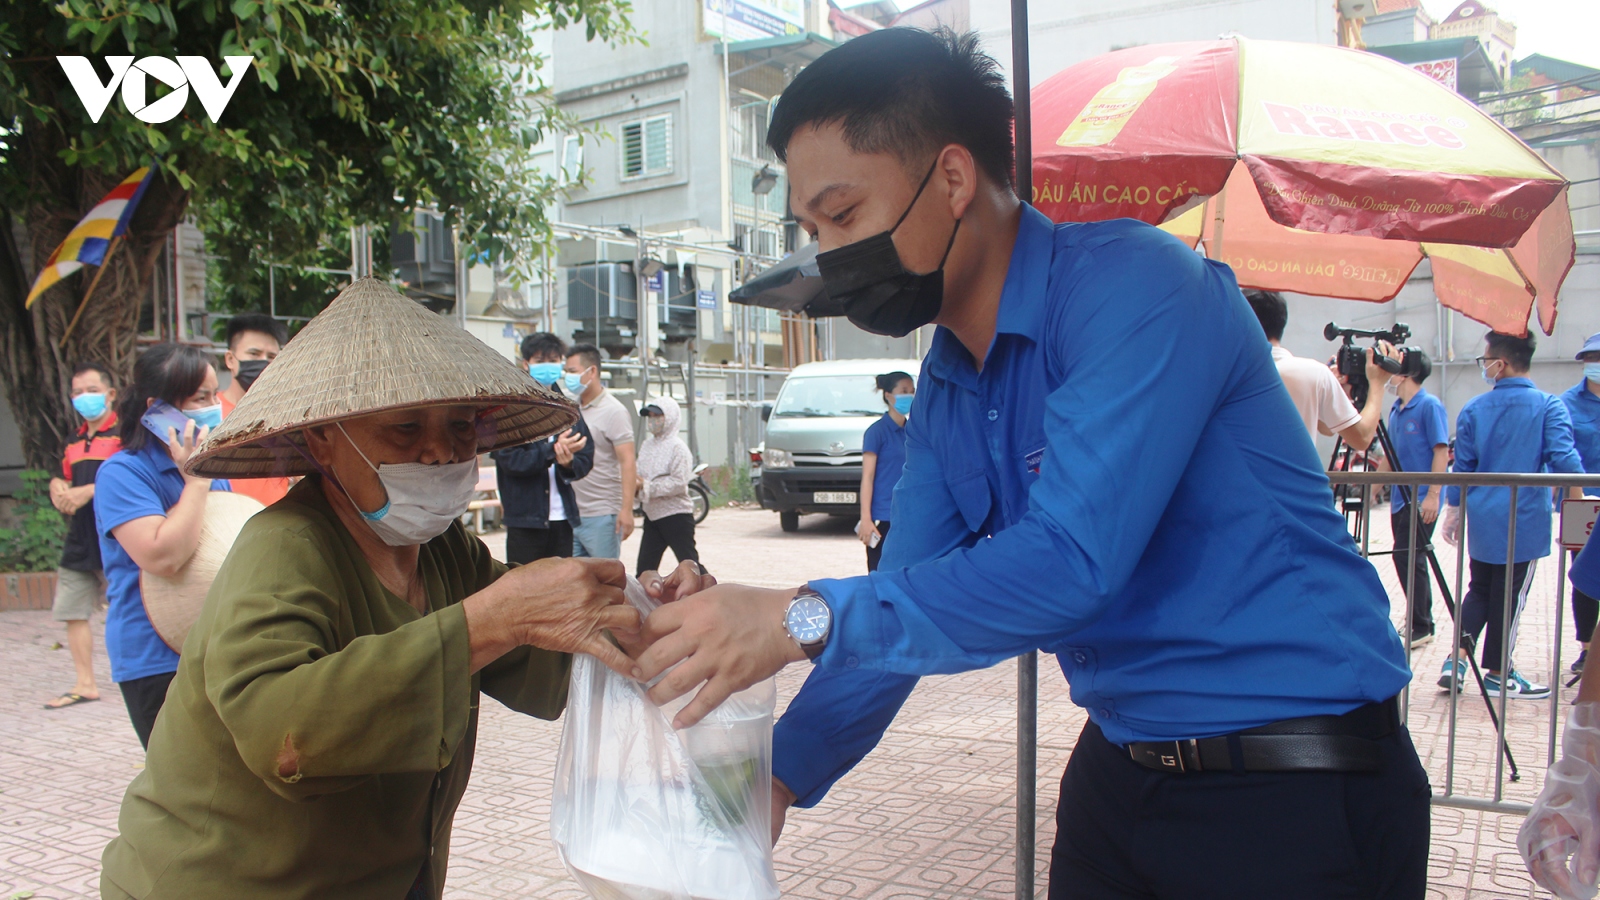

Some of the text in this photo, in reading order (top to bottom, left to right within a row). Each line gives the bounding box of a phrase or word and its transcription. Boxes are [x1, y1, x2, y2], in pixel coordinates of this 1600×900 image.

[1261, 100, 1468, 151] Ranee
[1068, 182, 1097, 203] ĂN
[1103, 185, 1151, 205] CAO
[1423, 203, 1454, 214] 100%
